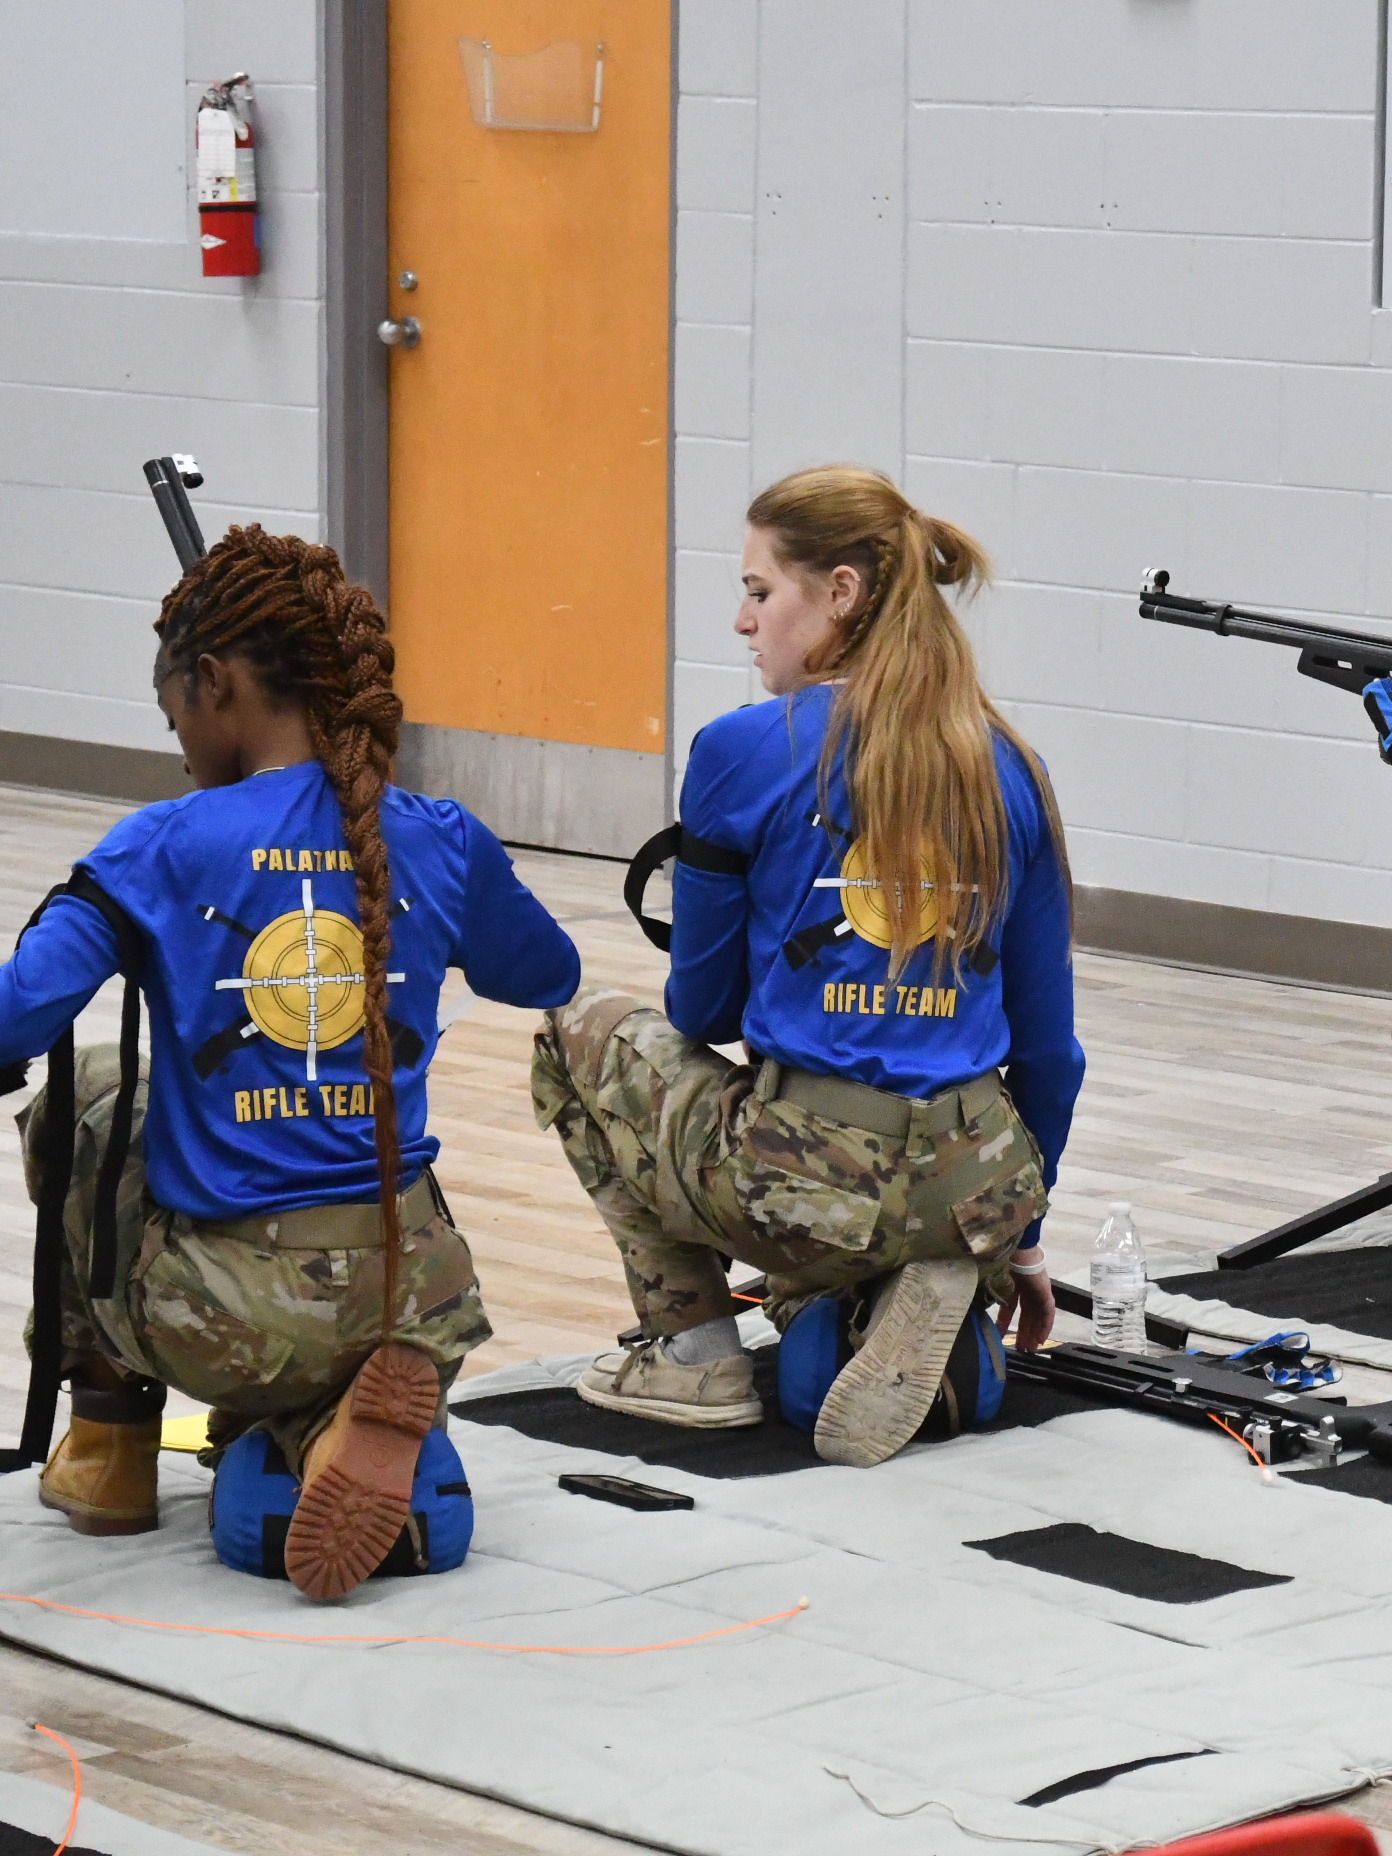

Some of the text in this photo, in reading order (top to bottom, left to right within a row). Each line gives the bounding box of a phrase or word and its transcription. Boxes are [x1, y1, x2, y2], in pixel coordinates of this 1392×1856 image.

[251, 848, 355, 873] PALATKA
[823, 983, 957, 1018] RIFLE TEAM
[234, 1084, 376, 1123] RIFLE TEA
